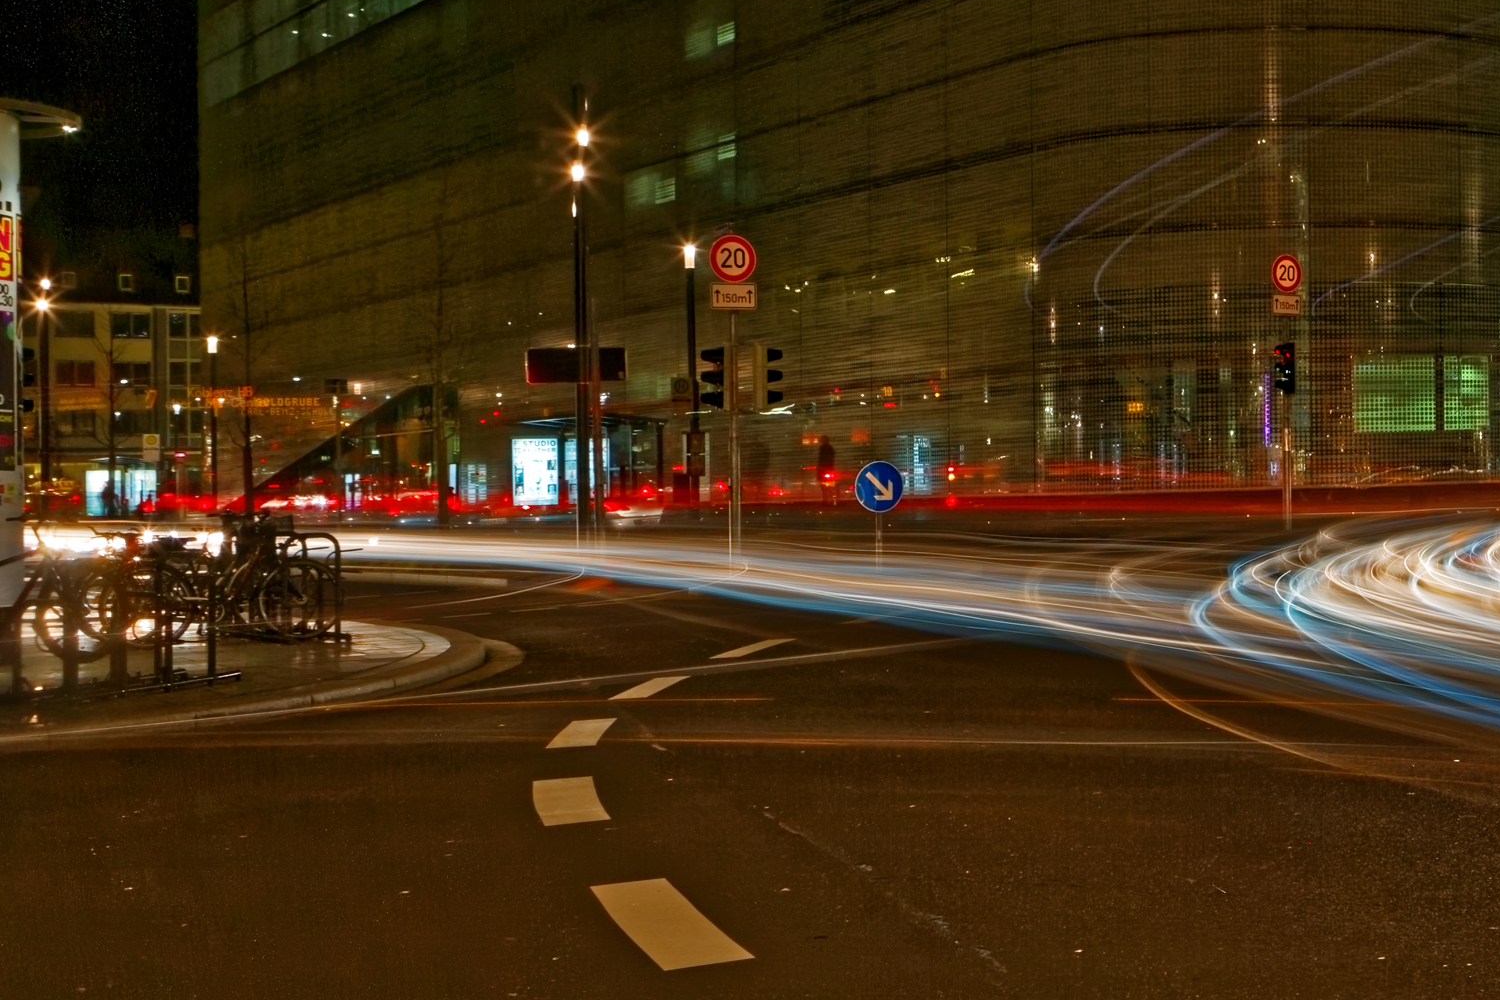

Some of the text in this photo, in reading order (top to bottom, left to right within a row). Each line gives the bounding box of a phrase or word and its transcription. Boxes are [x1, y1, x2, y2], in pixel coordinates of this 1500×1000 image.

[720, 248, 746, 269] 20
[1279, 264, 1296, 282] 20
[721, 293, 747, 304] 150m
[1280, 302, 1296, 310] 150m
[522, 440, 557, 448] STUDIO
